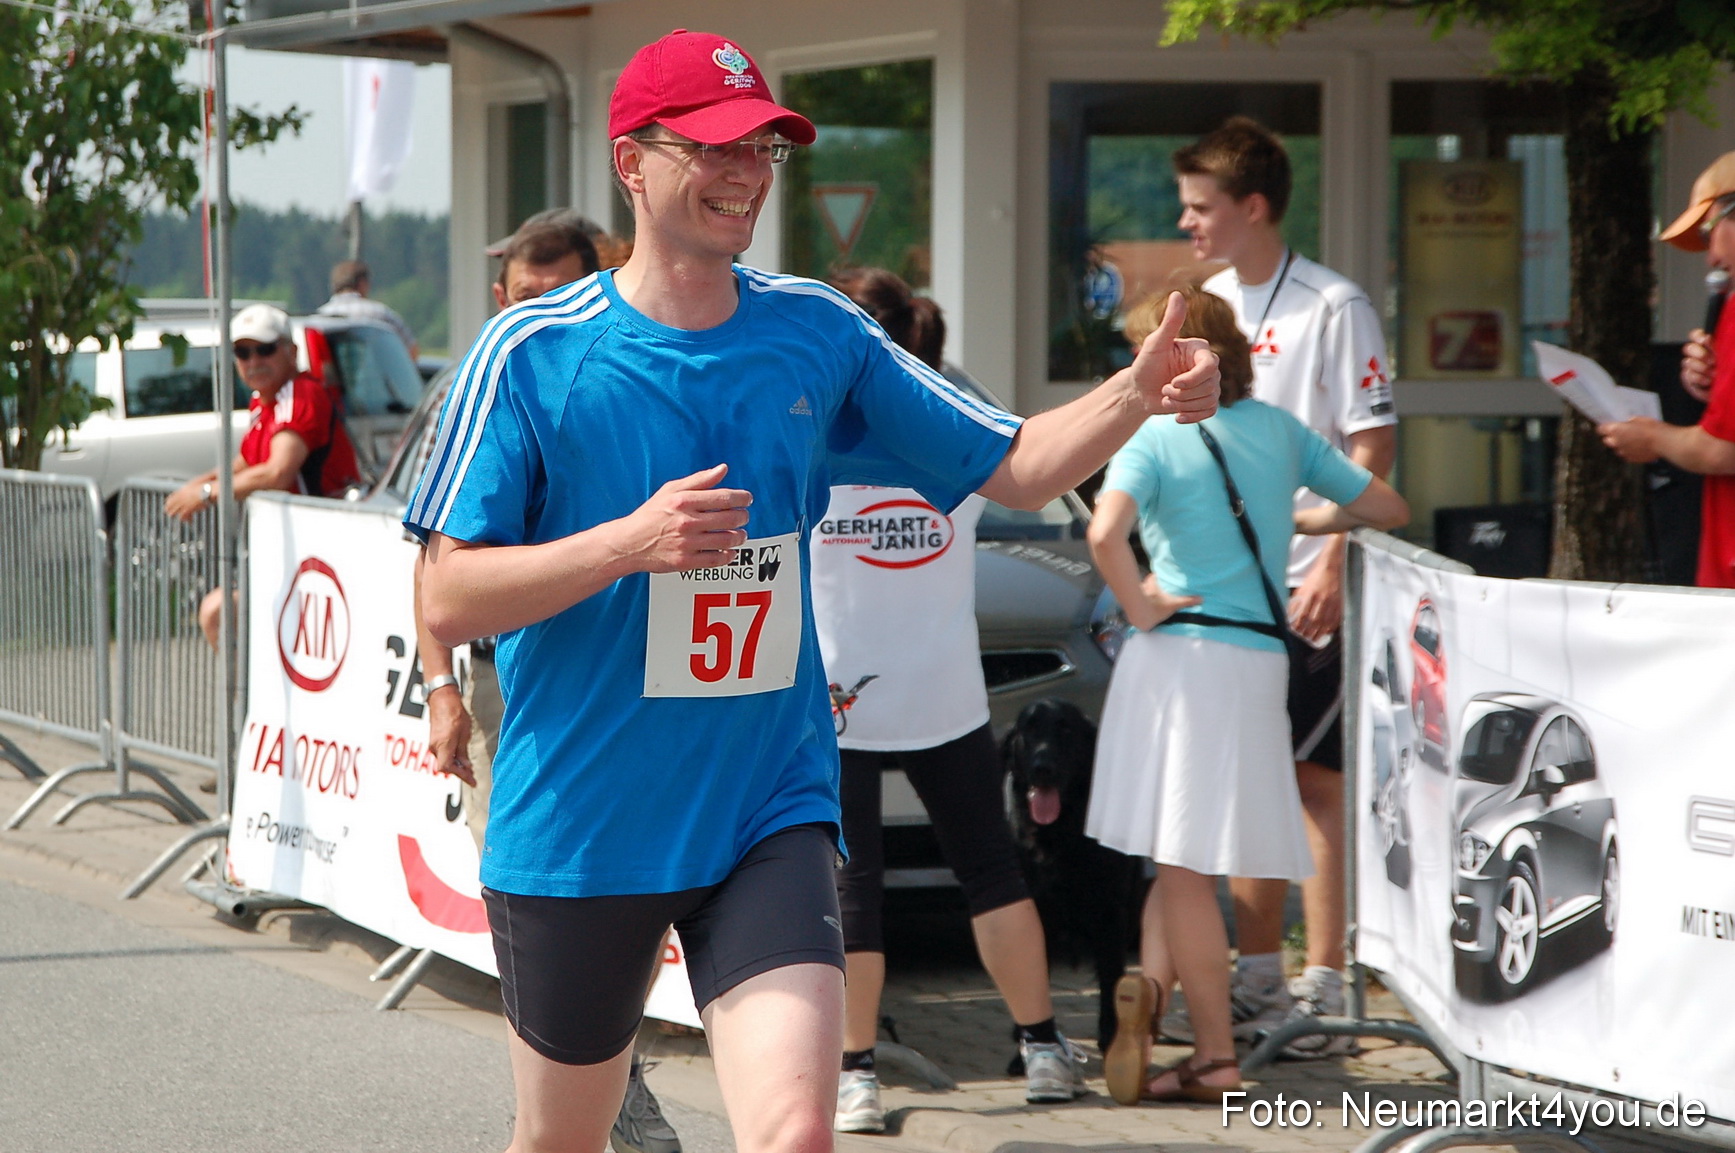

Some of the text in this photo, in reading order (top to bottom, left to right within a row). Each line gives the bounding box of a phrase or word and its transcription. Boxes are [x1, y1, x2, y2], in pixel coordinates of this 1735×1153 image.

[820, 517, 940, 535] GERHART &
[680, 567, 754, 581] WERBUNG
[293, 590, 336, 661] KIA
[690, 591, 772, 682] 57
[1681, 905, 1708, 937] MIT
